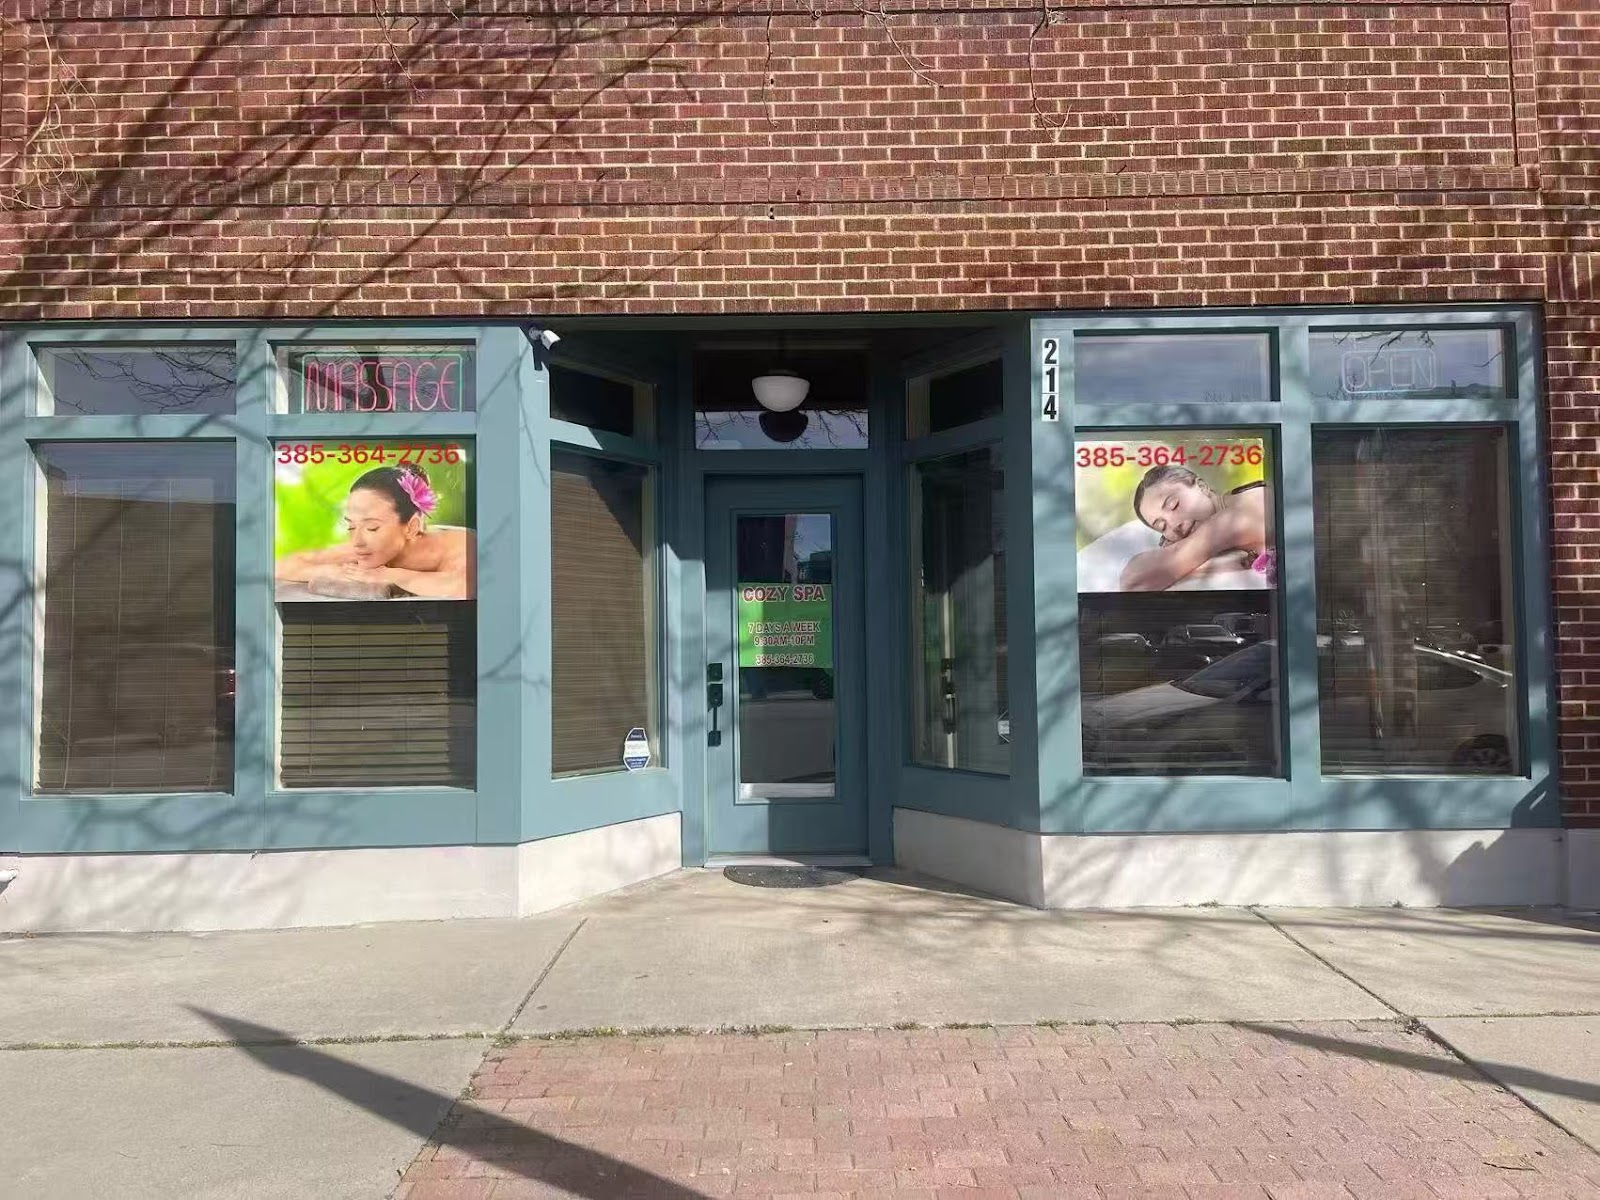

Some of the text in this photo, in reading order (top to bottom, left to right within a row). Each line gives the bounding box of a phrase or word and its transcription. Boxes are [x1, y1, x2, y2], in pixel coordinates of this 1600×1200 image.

[1043, 339, 1057, 420] 214
[1346, 354, 1432, 389] OPEN
[306, 361, 459, 412] MASSAGE
[277, 443, 461, 465] 385-364-2736
[1076, 445, 1263, 468] 385-364-2736
[742, 585, 826, 603] COZY SPA
[748, 621, 821, 633] 7 DAYS A WEEK
[756, 653, 815, 666] 385-364-2736
